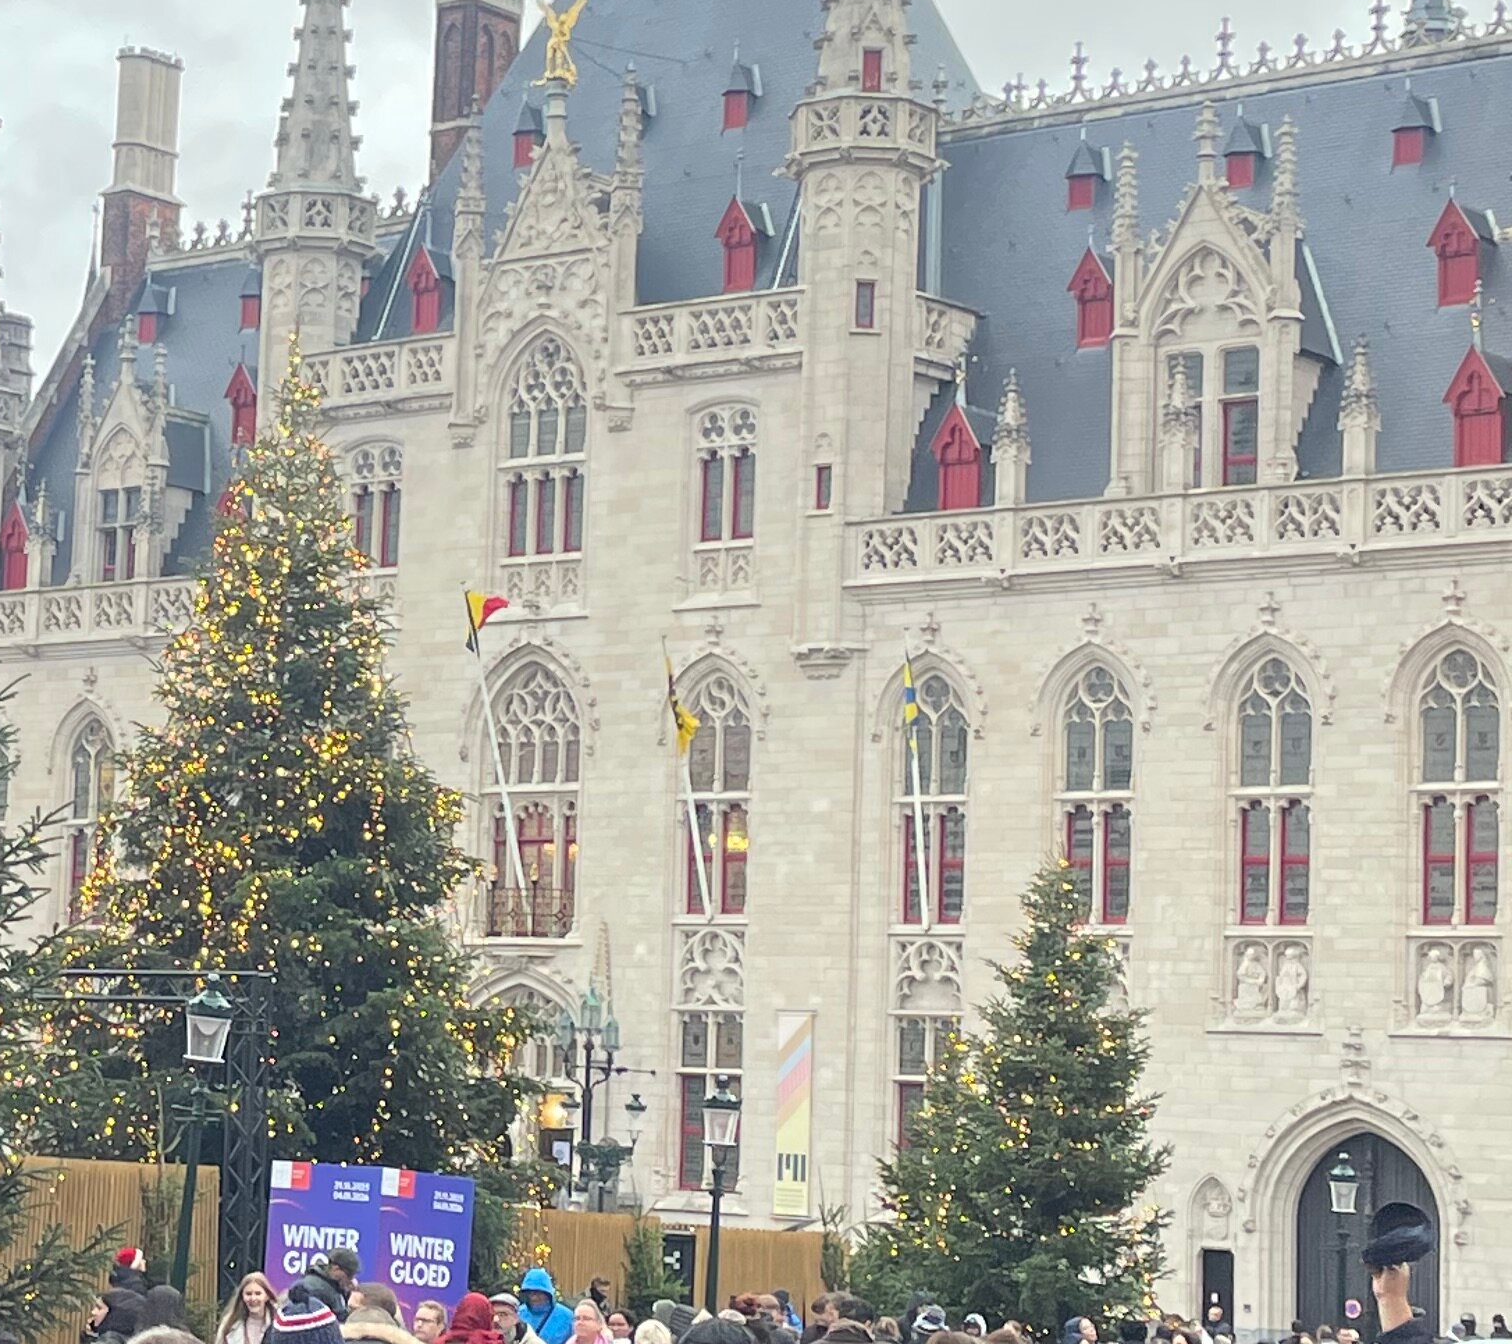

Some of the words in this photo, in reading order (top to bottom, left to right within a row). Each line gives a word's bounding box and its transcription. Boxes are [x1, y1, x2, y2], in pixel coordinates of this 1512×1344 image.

[283, 1224, 359, 1253] WINTER
[390, 1232, 456, 1263] WINTER
[390, 1259, 451, 1289] GLOED
